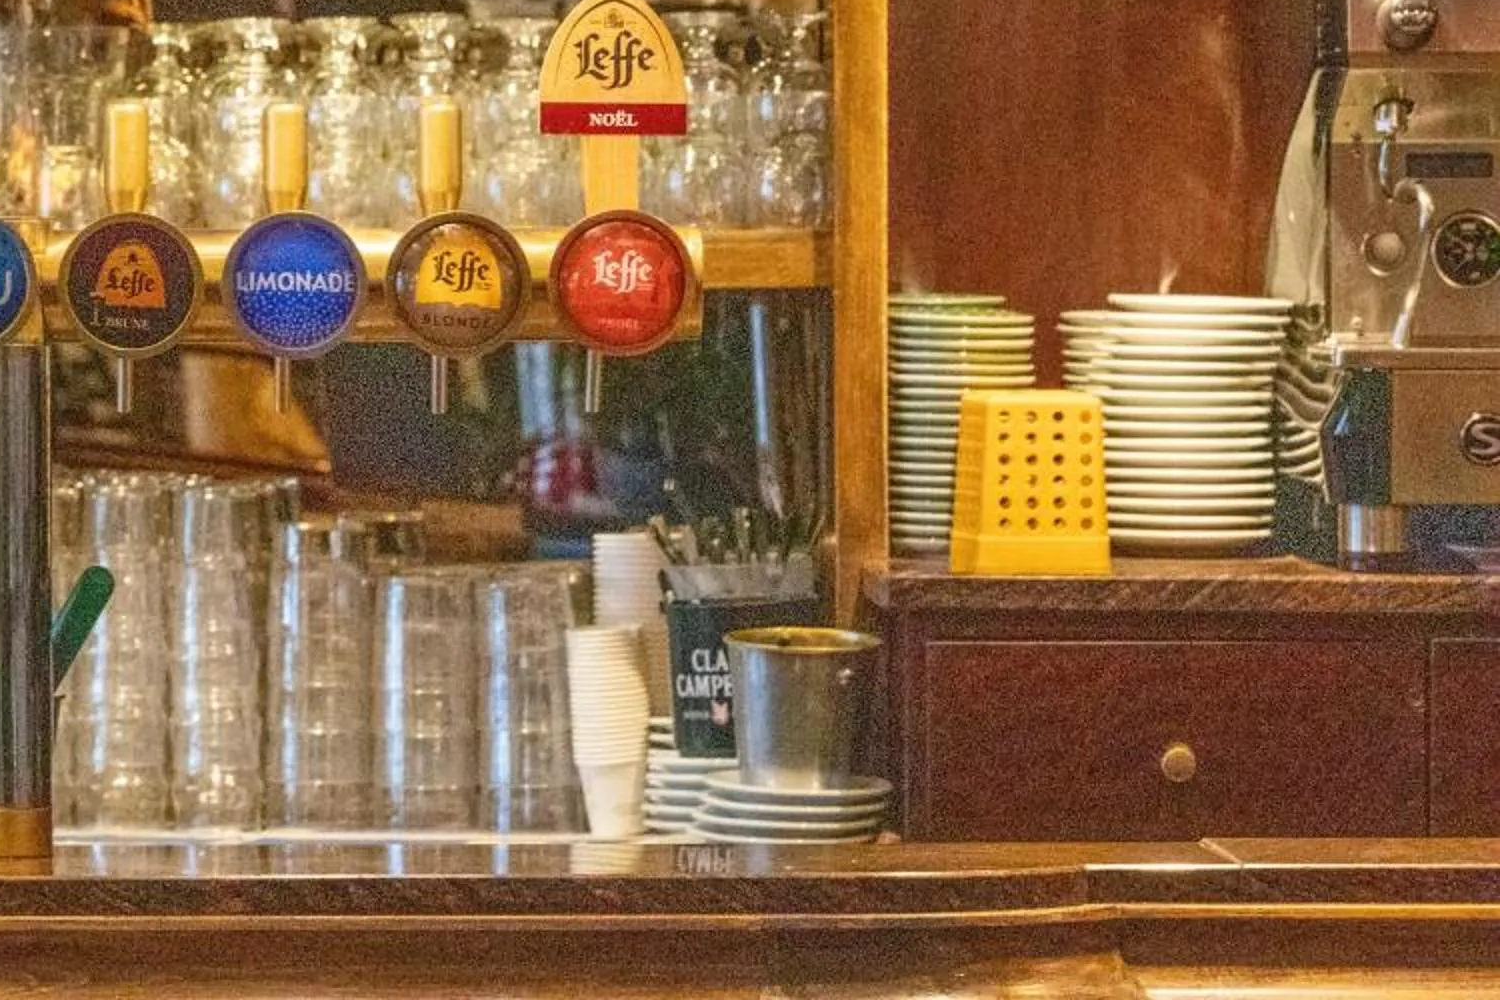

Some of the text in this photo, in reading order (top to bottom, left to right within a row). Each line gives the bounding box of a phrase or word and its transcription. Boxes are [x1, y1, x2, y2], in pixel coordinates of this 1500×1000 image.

[573, 30, 656, 91] Leffe
[588, 109, 639, 127] NOËL
[105, 266, 156, 299] Leffe
[236, 270, 356, 293] LIMONADE
[432, 250, 490, 293] Leffe
[592, 249, 653, 295] Leffe
[420, 312, 495, 329] BLONDE
